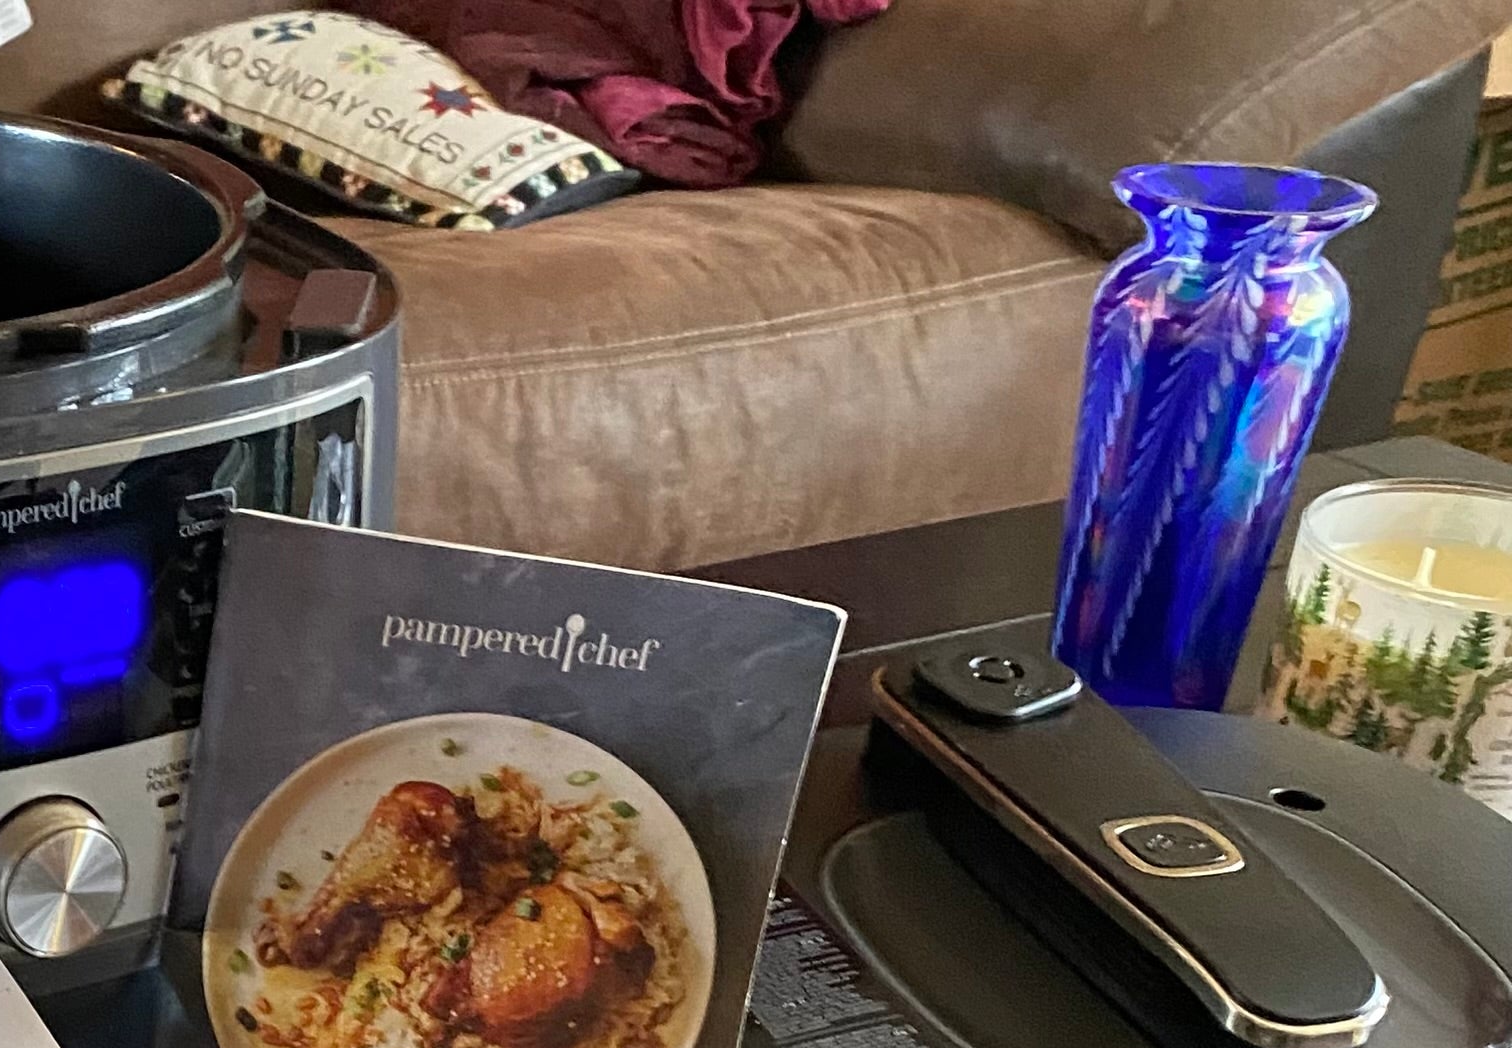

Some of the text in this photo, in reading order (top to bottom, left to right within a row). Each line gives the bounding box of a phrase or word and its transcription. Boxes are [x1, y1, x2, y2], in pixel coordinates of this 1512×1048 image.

[195, 41, 465, 165] NO SUNDAY SALES
[79, 481, 126, 514] chef
[381, 614, 660, 672] pampered chef
